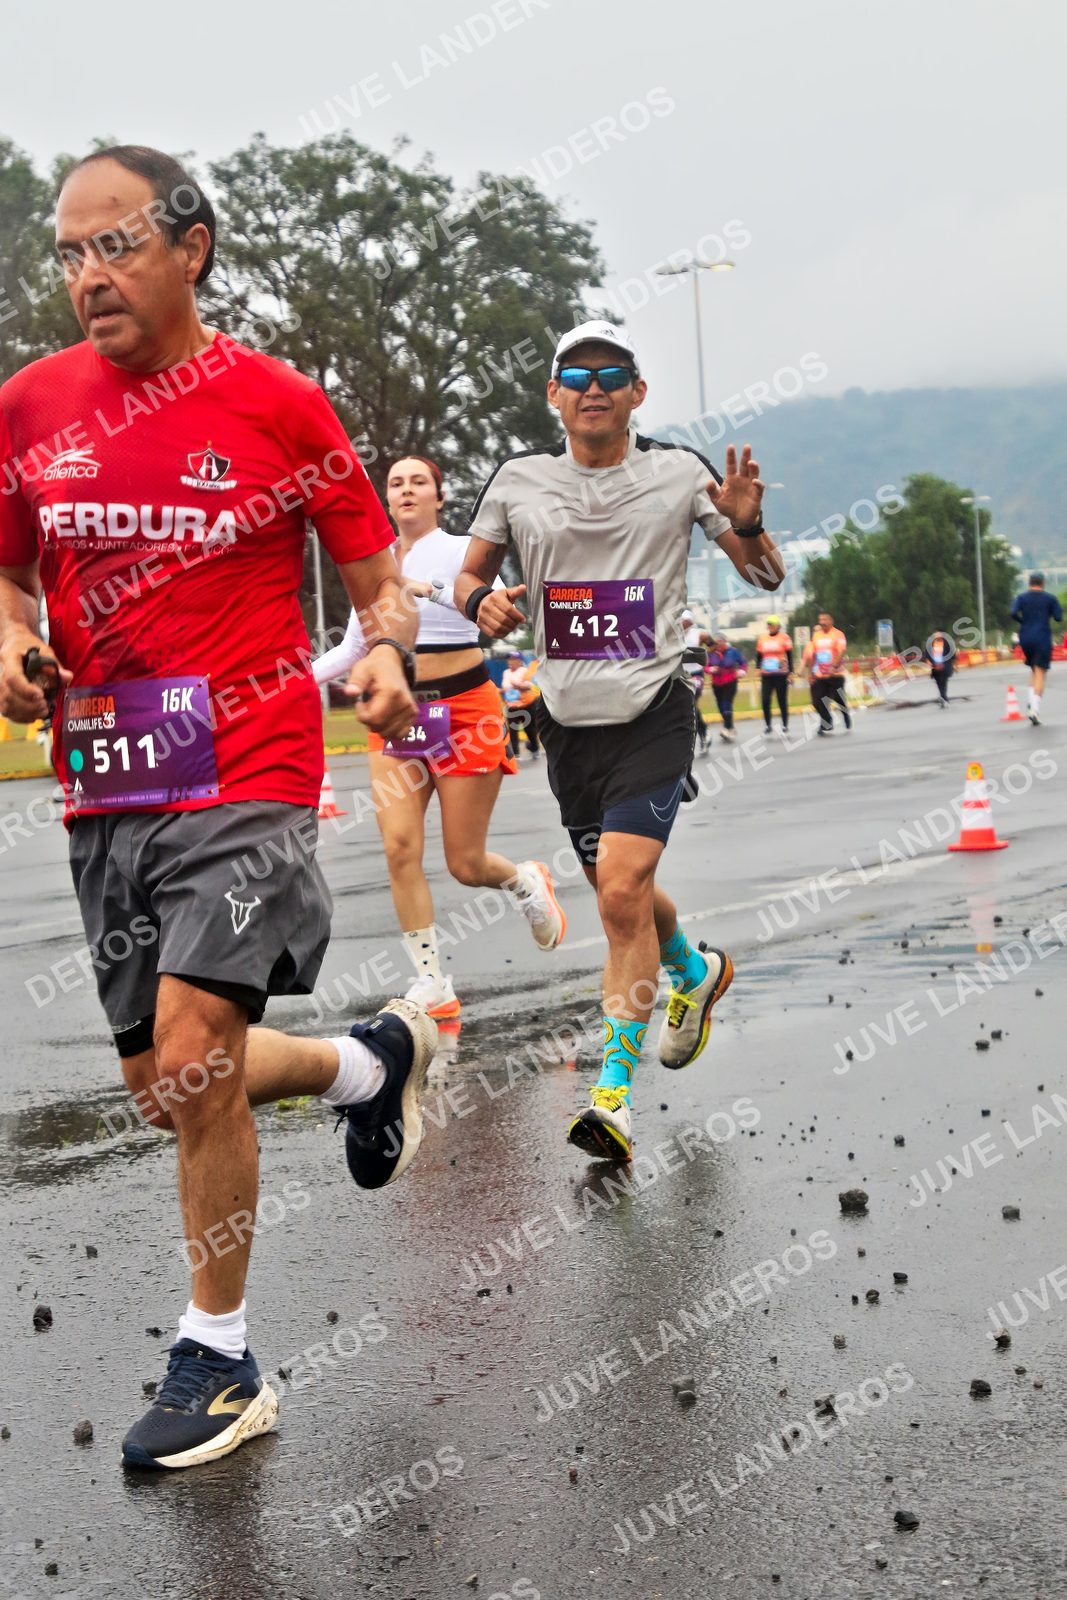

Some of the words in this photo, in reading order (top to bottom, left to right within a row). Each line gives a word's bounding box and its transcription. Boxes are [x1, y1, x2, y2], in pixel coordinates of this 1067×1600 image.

[44, 464, 98, 481] atletica
[38, 502, 237, 544] PERDURA
[549, 588, 593, 600] CARRERA
[623, 585, 646, 602] 15K
[569, 614, 619, 638] 412
[68, 695, 116, 719] CARRERA
[402, 726, 426, 741] 34
[92, 734, 156, 774] 511
